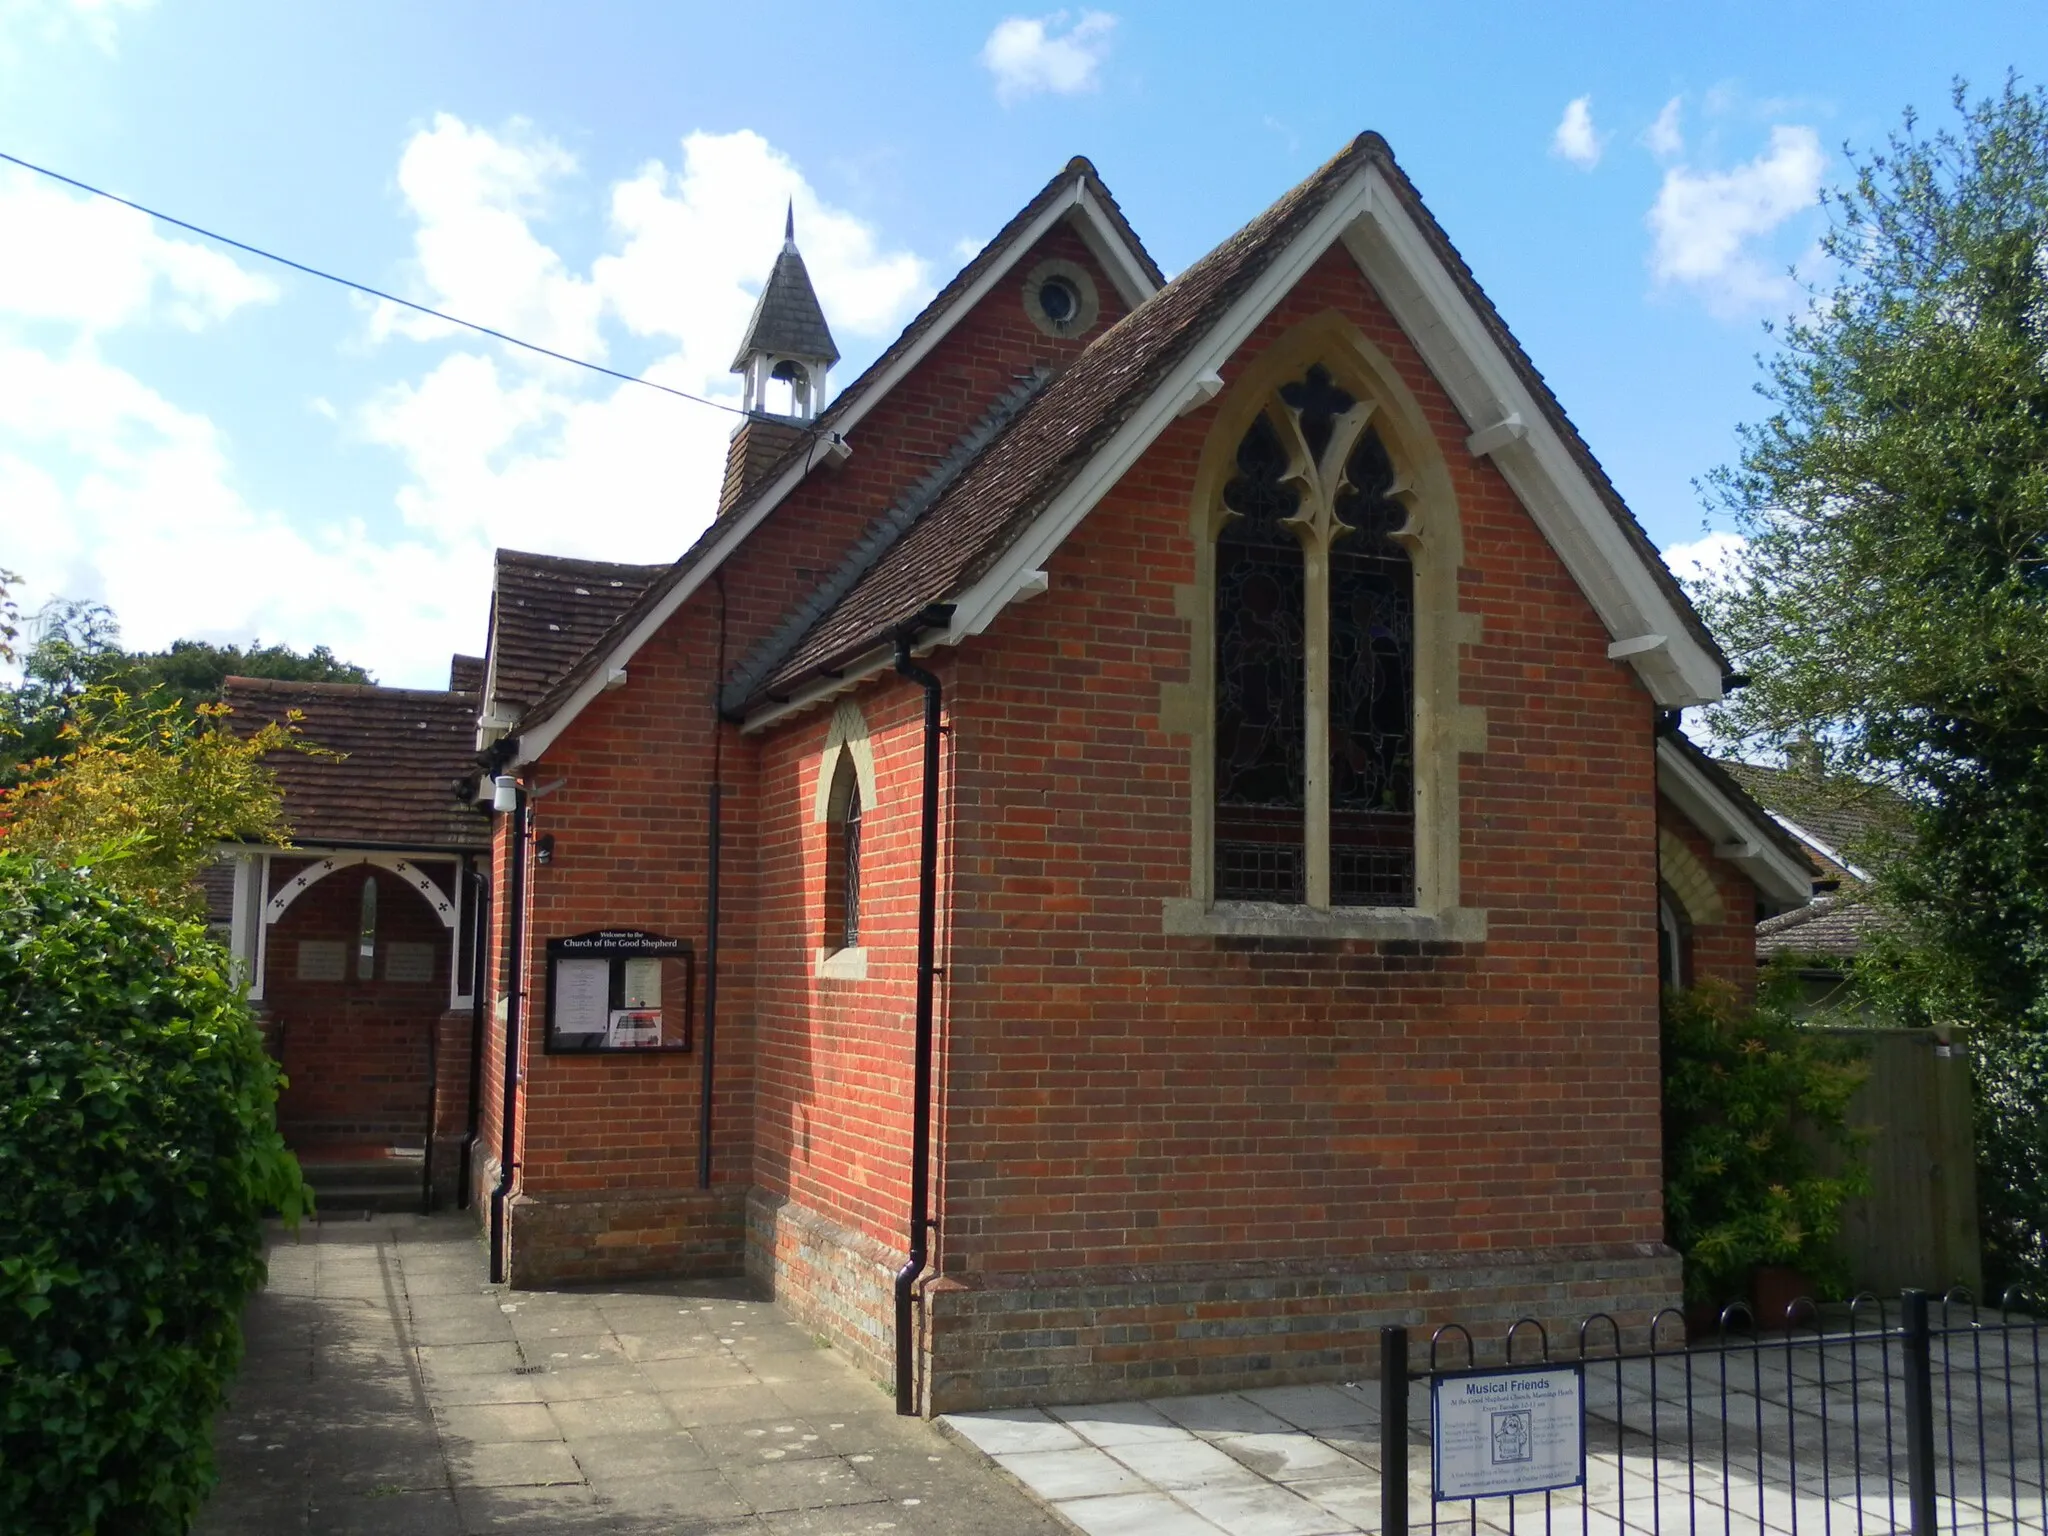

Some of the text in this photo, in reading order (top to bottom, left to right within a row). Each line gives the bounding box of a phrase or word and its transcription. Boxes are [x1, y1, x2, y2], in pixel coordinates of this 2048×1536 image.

[563, 939, 678, 949] Church of the Good Shepherd
[1466, 1378, 1550, 1395] Musical Friends
